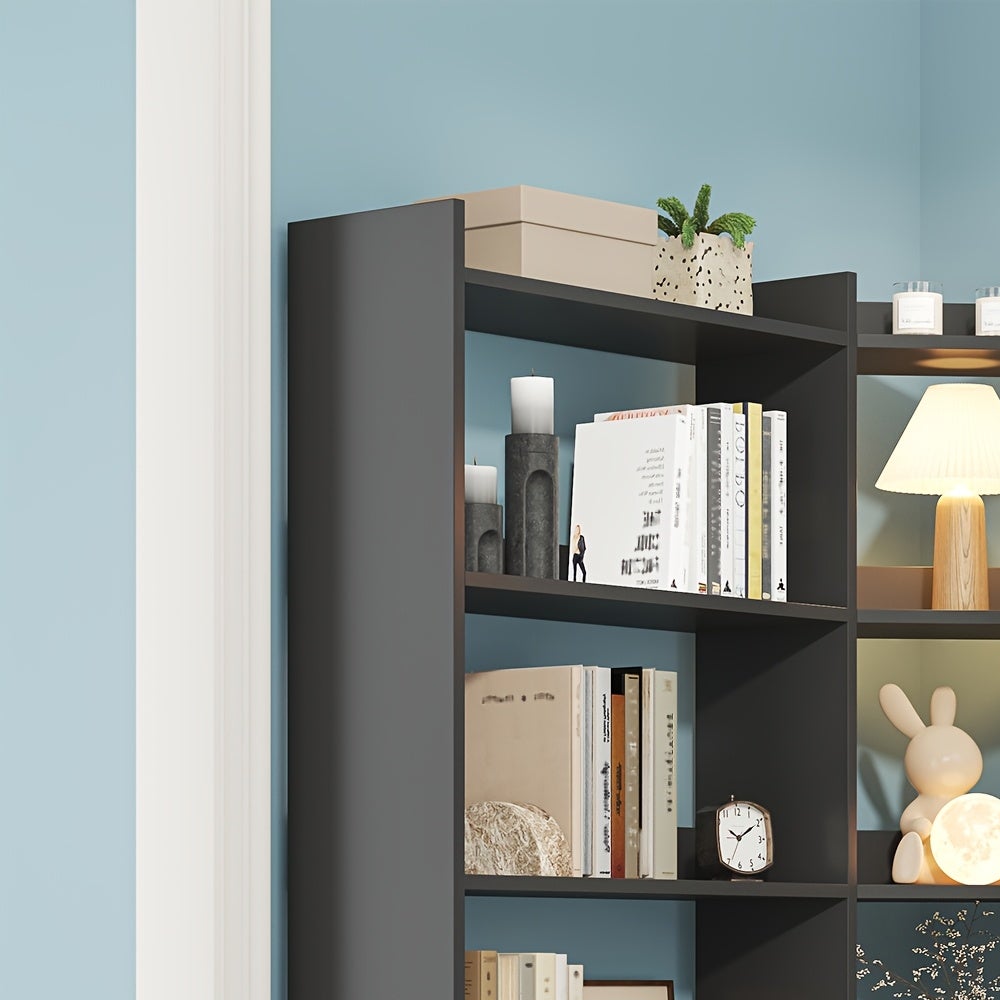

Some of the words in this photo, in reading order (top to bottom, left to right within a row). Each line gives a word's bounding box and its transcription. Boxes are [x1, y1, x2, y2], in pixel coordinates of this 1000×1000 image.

[735, 807, 741, 817] 12
[756, 818, 760, 828] 2
[758, 835, 762, 844] 3
[749, 858, 754, 868] 5
